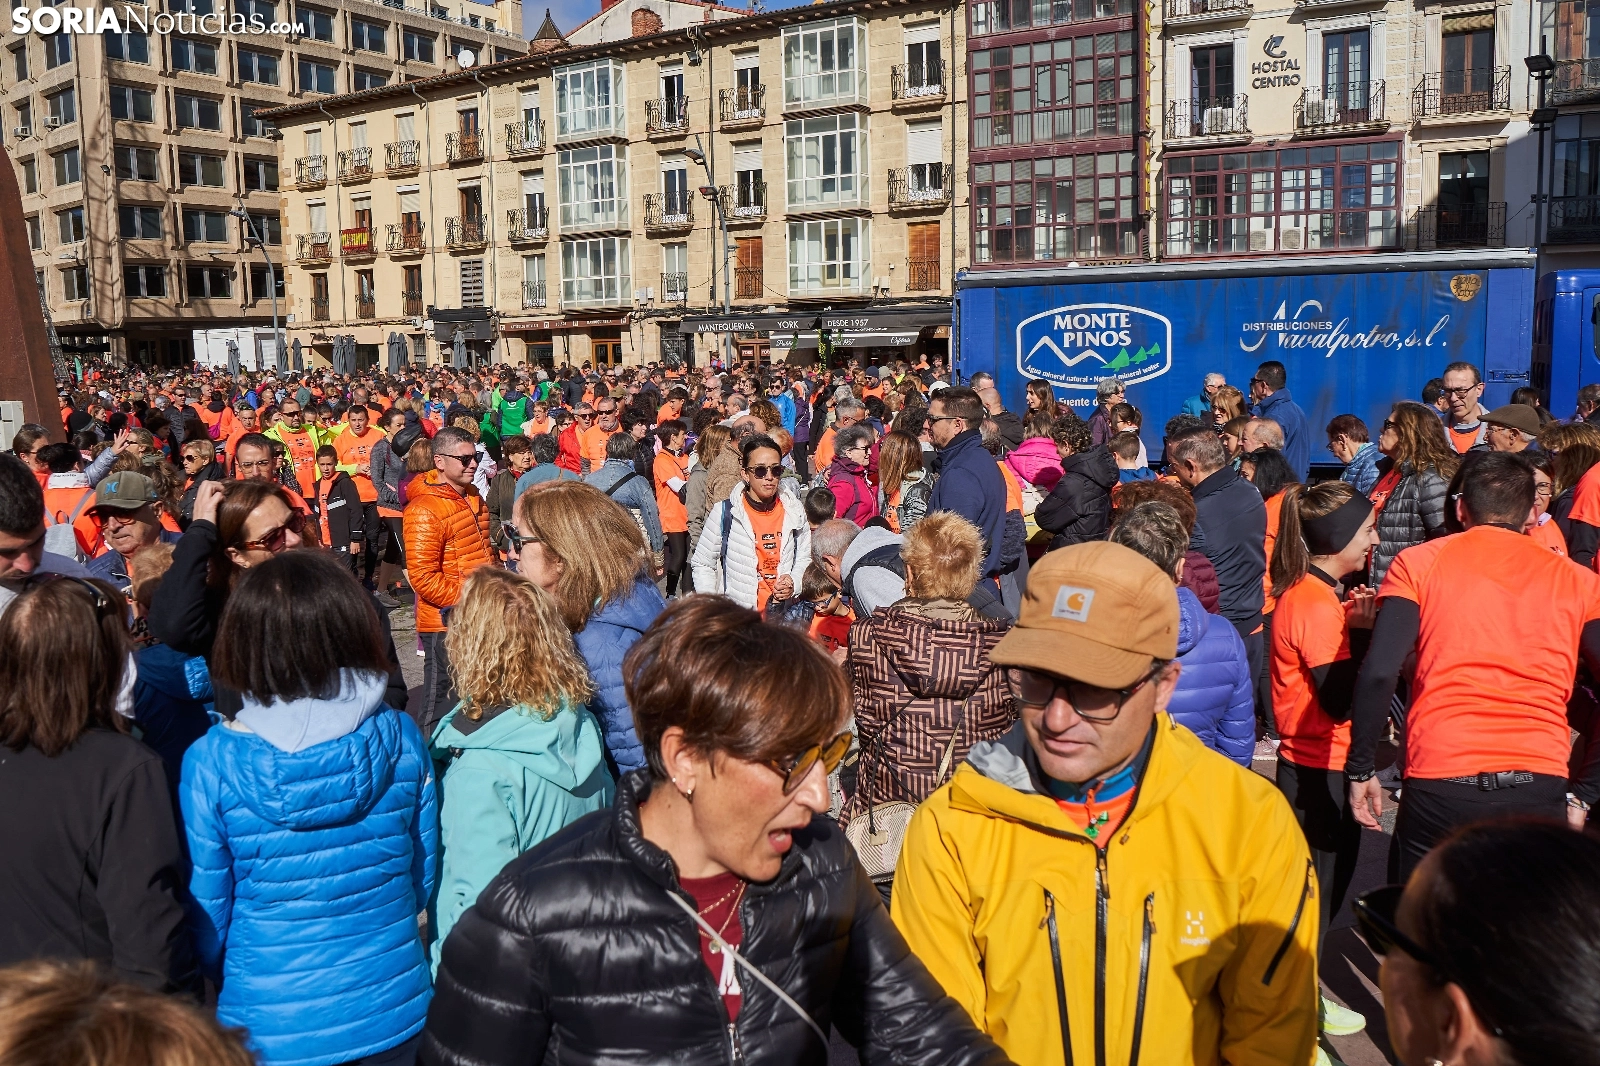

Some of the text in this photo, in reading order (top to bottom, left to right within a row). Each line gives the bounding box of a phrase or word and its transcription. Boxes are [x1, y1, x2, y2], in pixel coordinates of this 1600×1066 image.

[1252, 59, 1300, 74] HOSTAL
[1252, 74, 1301, 89] CENTRO
[697, 320, 799, 332] MANTEQUERIAS YORK
[827, 318, 869, 327] DESDE 1957
[1053, 312, 1132, 331] MONTE
[1242, 321, 1333, 332] DISTRIBUCIONES
[1063, 330, 1132, 348] PINOS
[1025, 364, 1042, 374] Agua
[1042, 370, 1066, 381] mineral
[1066, 375, 1089, 383] natural
[1117, 369, 1142, 380] mineral
[1142, 362, 1160, 374] water
[1058, 397, 1090, 407] Fuente
